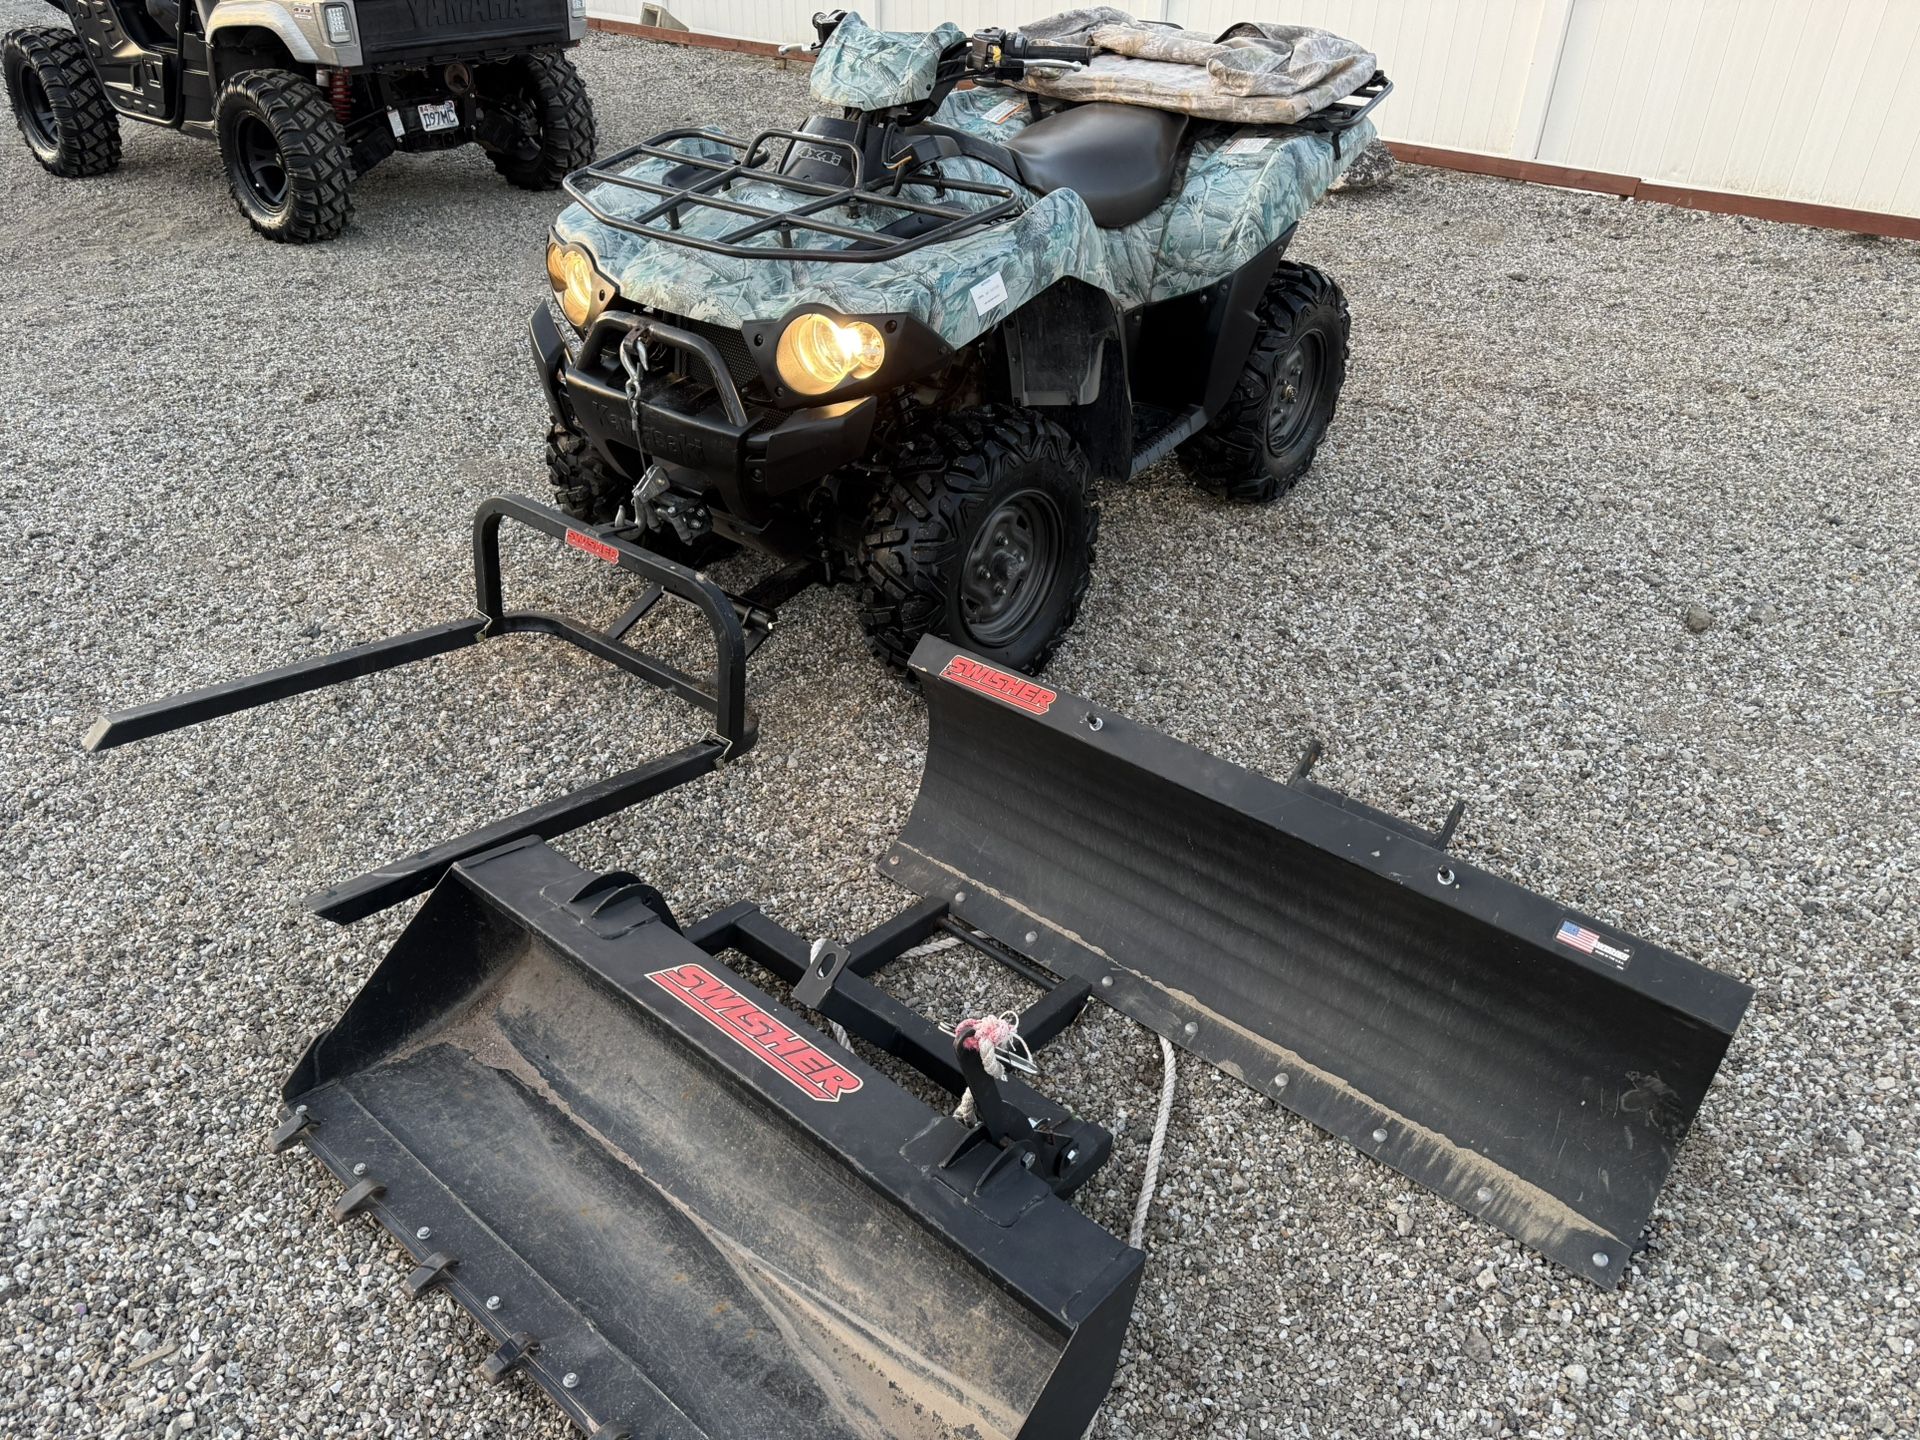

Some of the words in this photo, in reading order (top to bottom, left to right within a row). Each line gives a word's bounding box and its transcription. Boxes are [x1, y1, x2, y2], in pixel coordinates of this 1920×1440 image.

[567, 529, 619, 561] SWISHER
[949, 656, 1057, 709] SWISHER
[661, 964, 862, 1100] SWISHER
